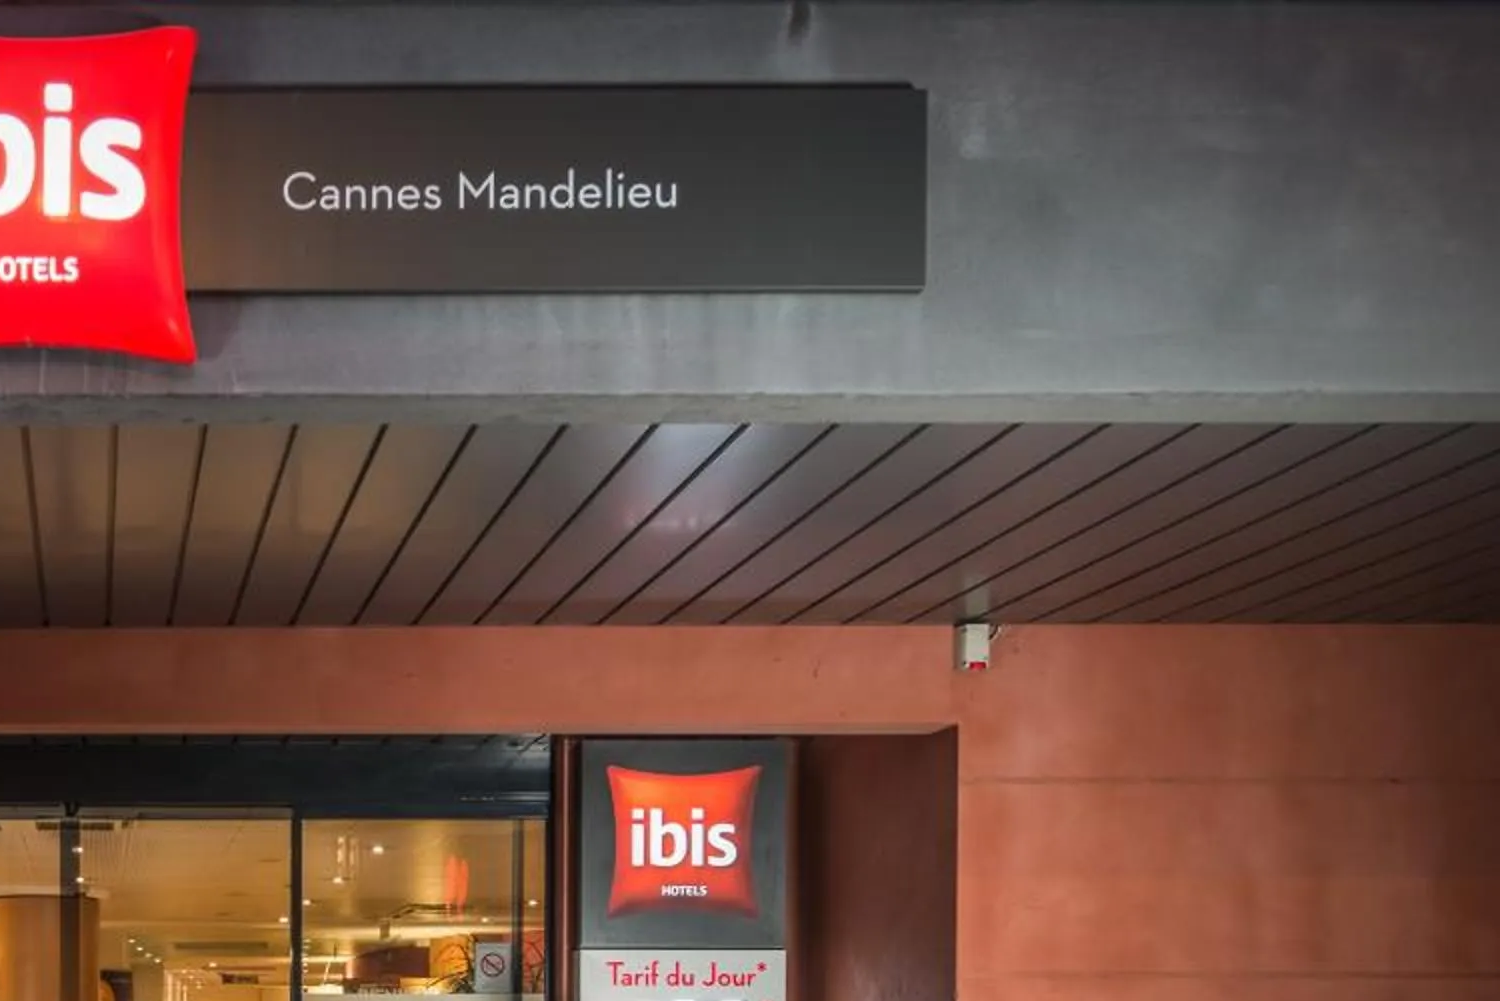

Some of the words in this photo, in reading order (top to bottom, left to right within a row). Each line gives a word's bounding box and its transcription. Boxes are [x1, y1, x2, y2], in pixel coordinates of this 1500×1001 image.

[283, 171, 442, 211] Cannes
[458, 168, 678, 210] Mandelieu
[630, 807, 738, 867] ibis
[661, 884, 708, 897] HOTELS
[606, 961, 659, 987] Tarif
[666, 961, 695, 987] du
